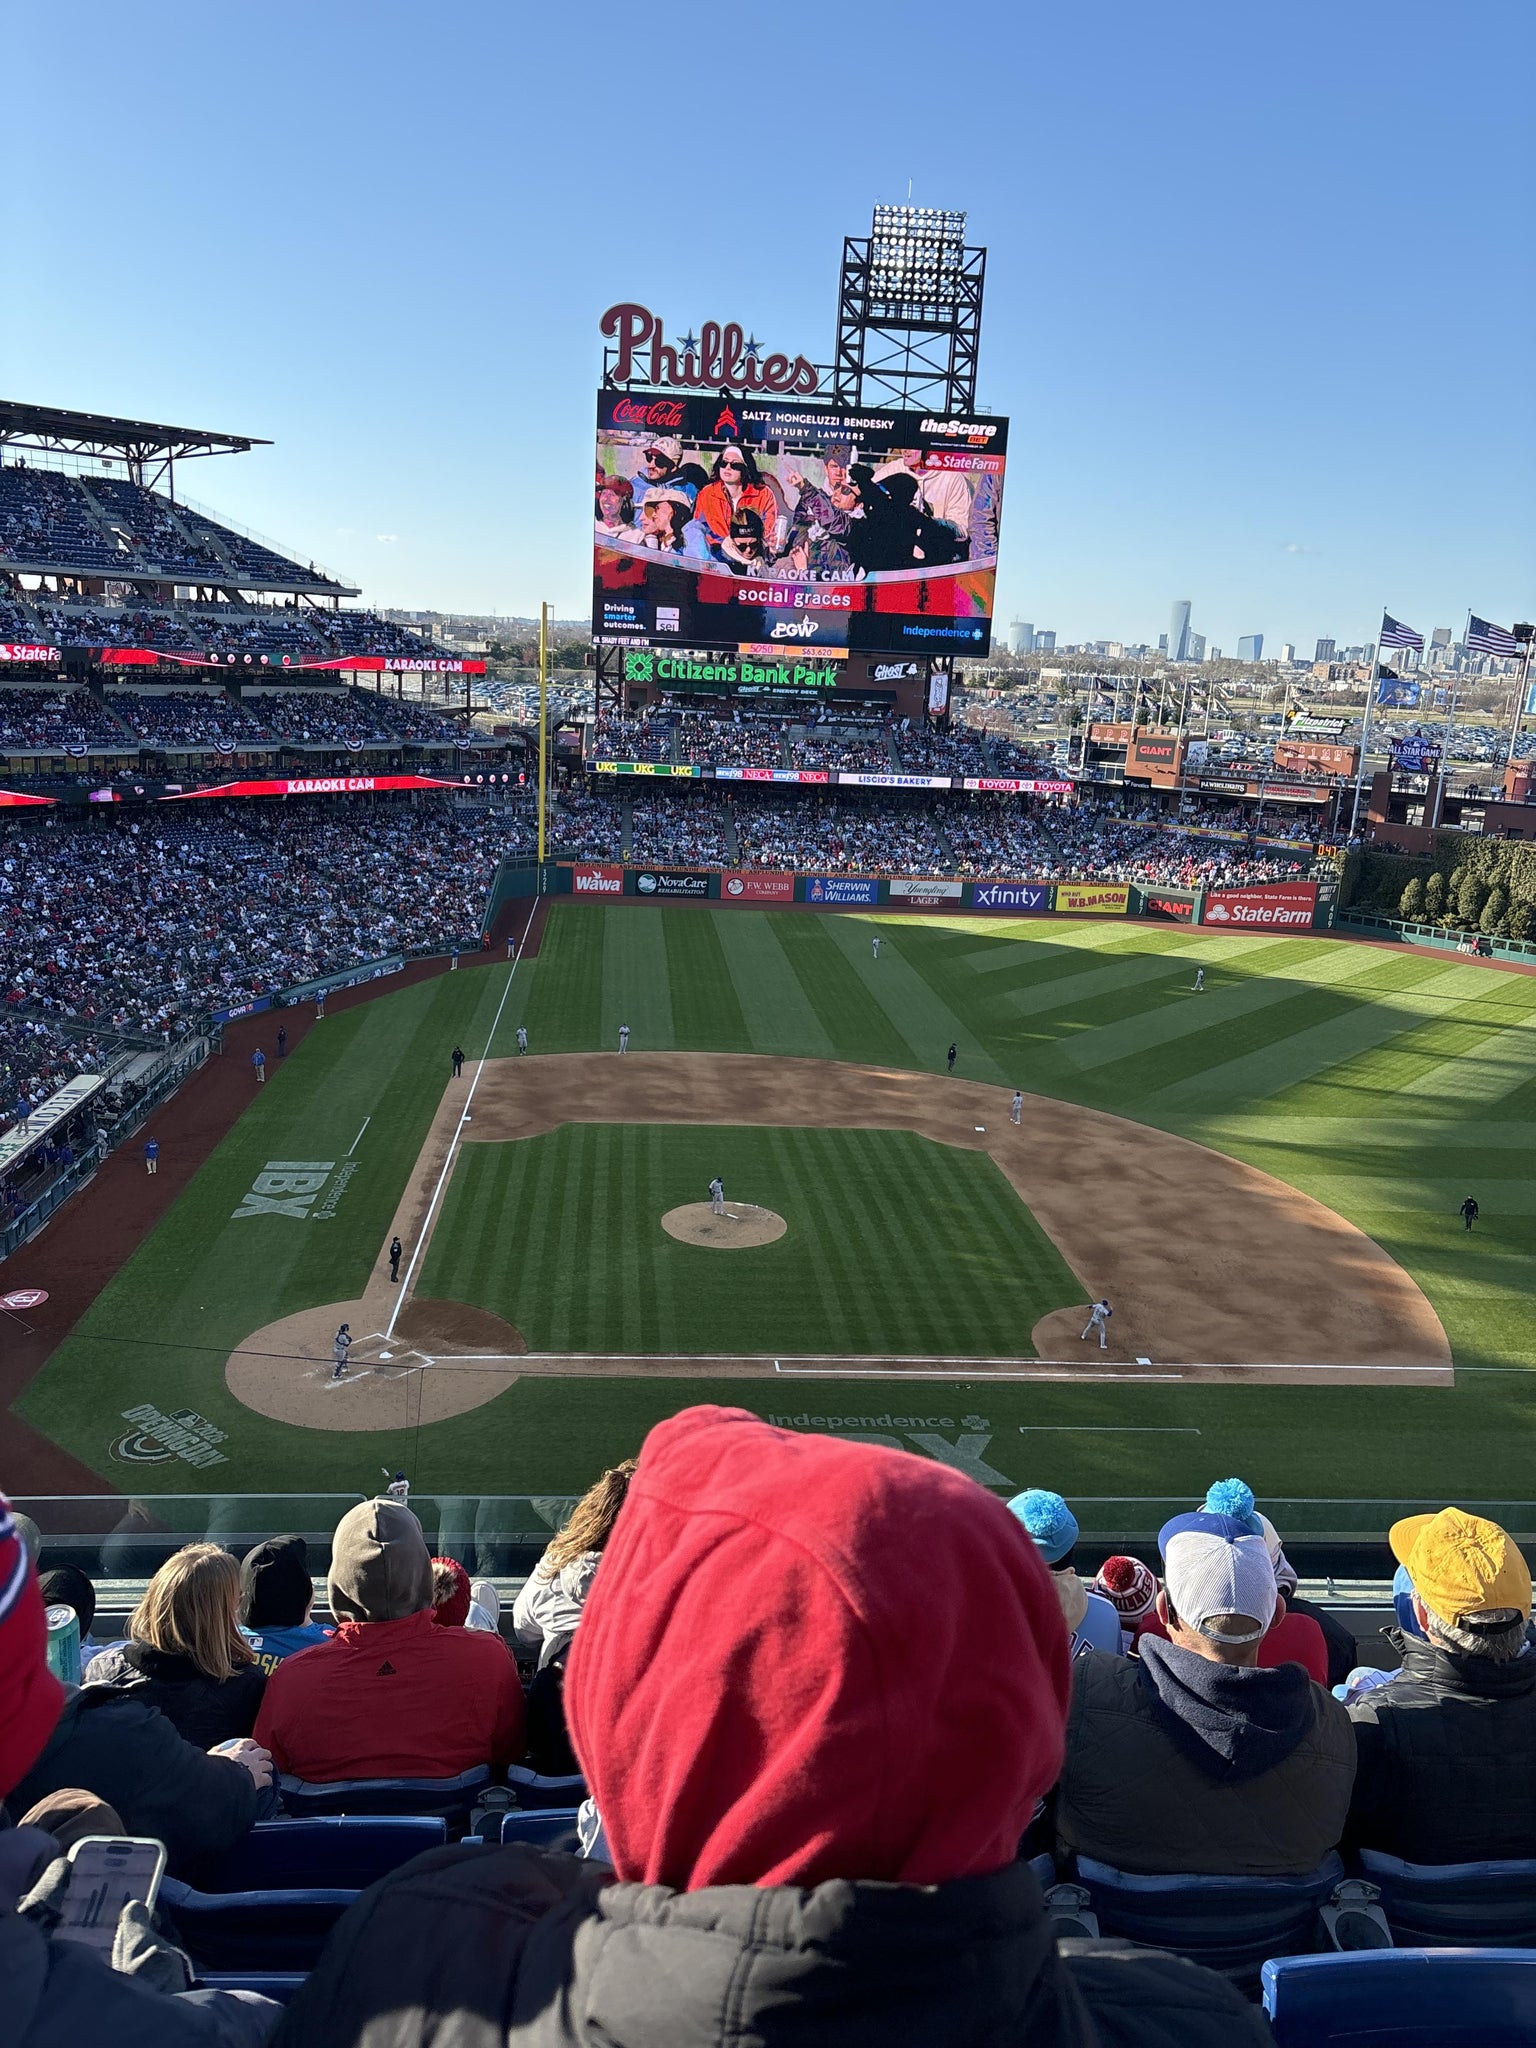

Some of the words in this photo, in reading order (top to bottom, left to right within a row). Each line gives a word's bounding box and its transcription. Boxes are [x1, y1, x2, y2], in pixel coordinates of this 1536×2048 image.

[600, 302, 819, 395] Phillies
[741, 410, 771, 421] SALTZ
[775, 413, 840, 426] MONGELUZZI
[843, 417, 895, 430] BENDESKY
[771, 426, 810, 437] INJURY
[817, 430, 865, 441] LAWYERS
[920, 419, 997, 436] theScore
[746, 565, 817, 581] KARAOKE
[821, 570, 854, 581] CAM
[738, 587, 788, 603] social
[794, 591, 851, 608] graces
[604, 603, 635, 614] Driving
[604, 613, 637, 621] smarter
[603, 621, 647, 631] outcomes.
[775, 621, 815, 638] PGW
[903, 625, 970, 638] Independence
[801, 648, 832, 657] $63,620
[385, 659, 437, 671] KARAOKE
[439, 661, 463, 671] CAM
[874, 662, 910, 681] GHOST
[657, 663, 737, 681] Citizens
[740, 664, 791, 684] Bank
[793, 666, 838, 687] Park
[1293, 711, 1344, 728] Fitzpatrick
[1389, 745, 1401, 754] ALL
[1402, 746, 1420, 756] STAR
[1420, 747, 1441, 758] GAME
[596, 762, 617, 773] UKG
[633, 764, 655, 775] UKG
[671, 765, 692, 776] UKG
[745, 770, 772, 779] NECA
[801, 773, 827, 781] NECA
[858, 776, 895, 785] LISCIO'S
[897, 777, 932, 786] BAKERY
[288, 780, 346, 793] KARAOKE
[348, 778, 375, 790] CAM
[982, 781, 1017, 789] TOYOTA
[1037, 782, 1072, 791] TOYOTA
[576, 876, 621, 891] Wawa
[657, 875, 708, 888] NovaCare
[764, 882, 790, 890] WEBB
[826, 880, 870, 891] SHERWIN
[902, 882, 950, 896] Yuengling
[977, 885, 1041, 906] xfinity
[909, 897, 940, 905] LAGER
[231, 1161, 336, 1219] IBX
[321, 1161, 362, 1210] Independence
[769, 1414, 955, 1429] Independence
[121, 1404, 200, 1451] OPENING
[177, 1441, 230, 1469] DAY
